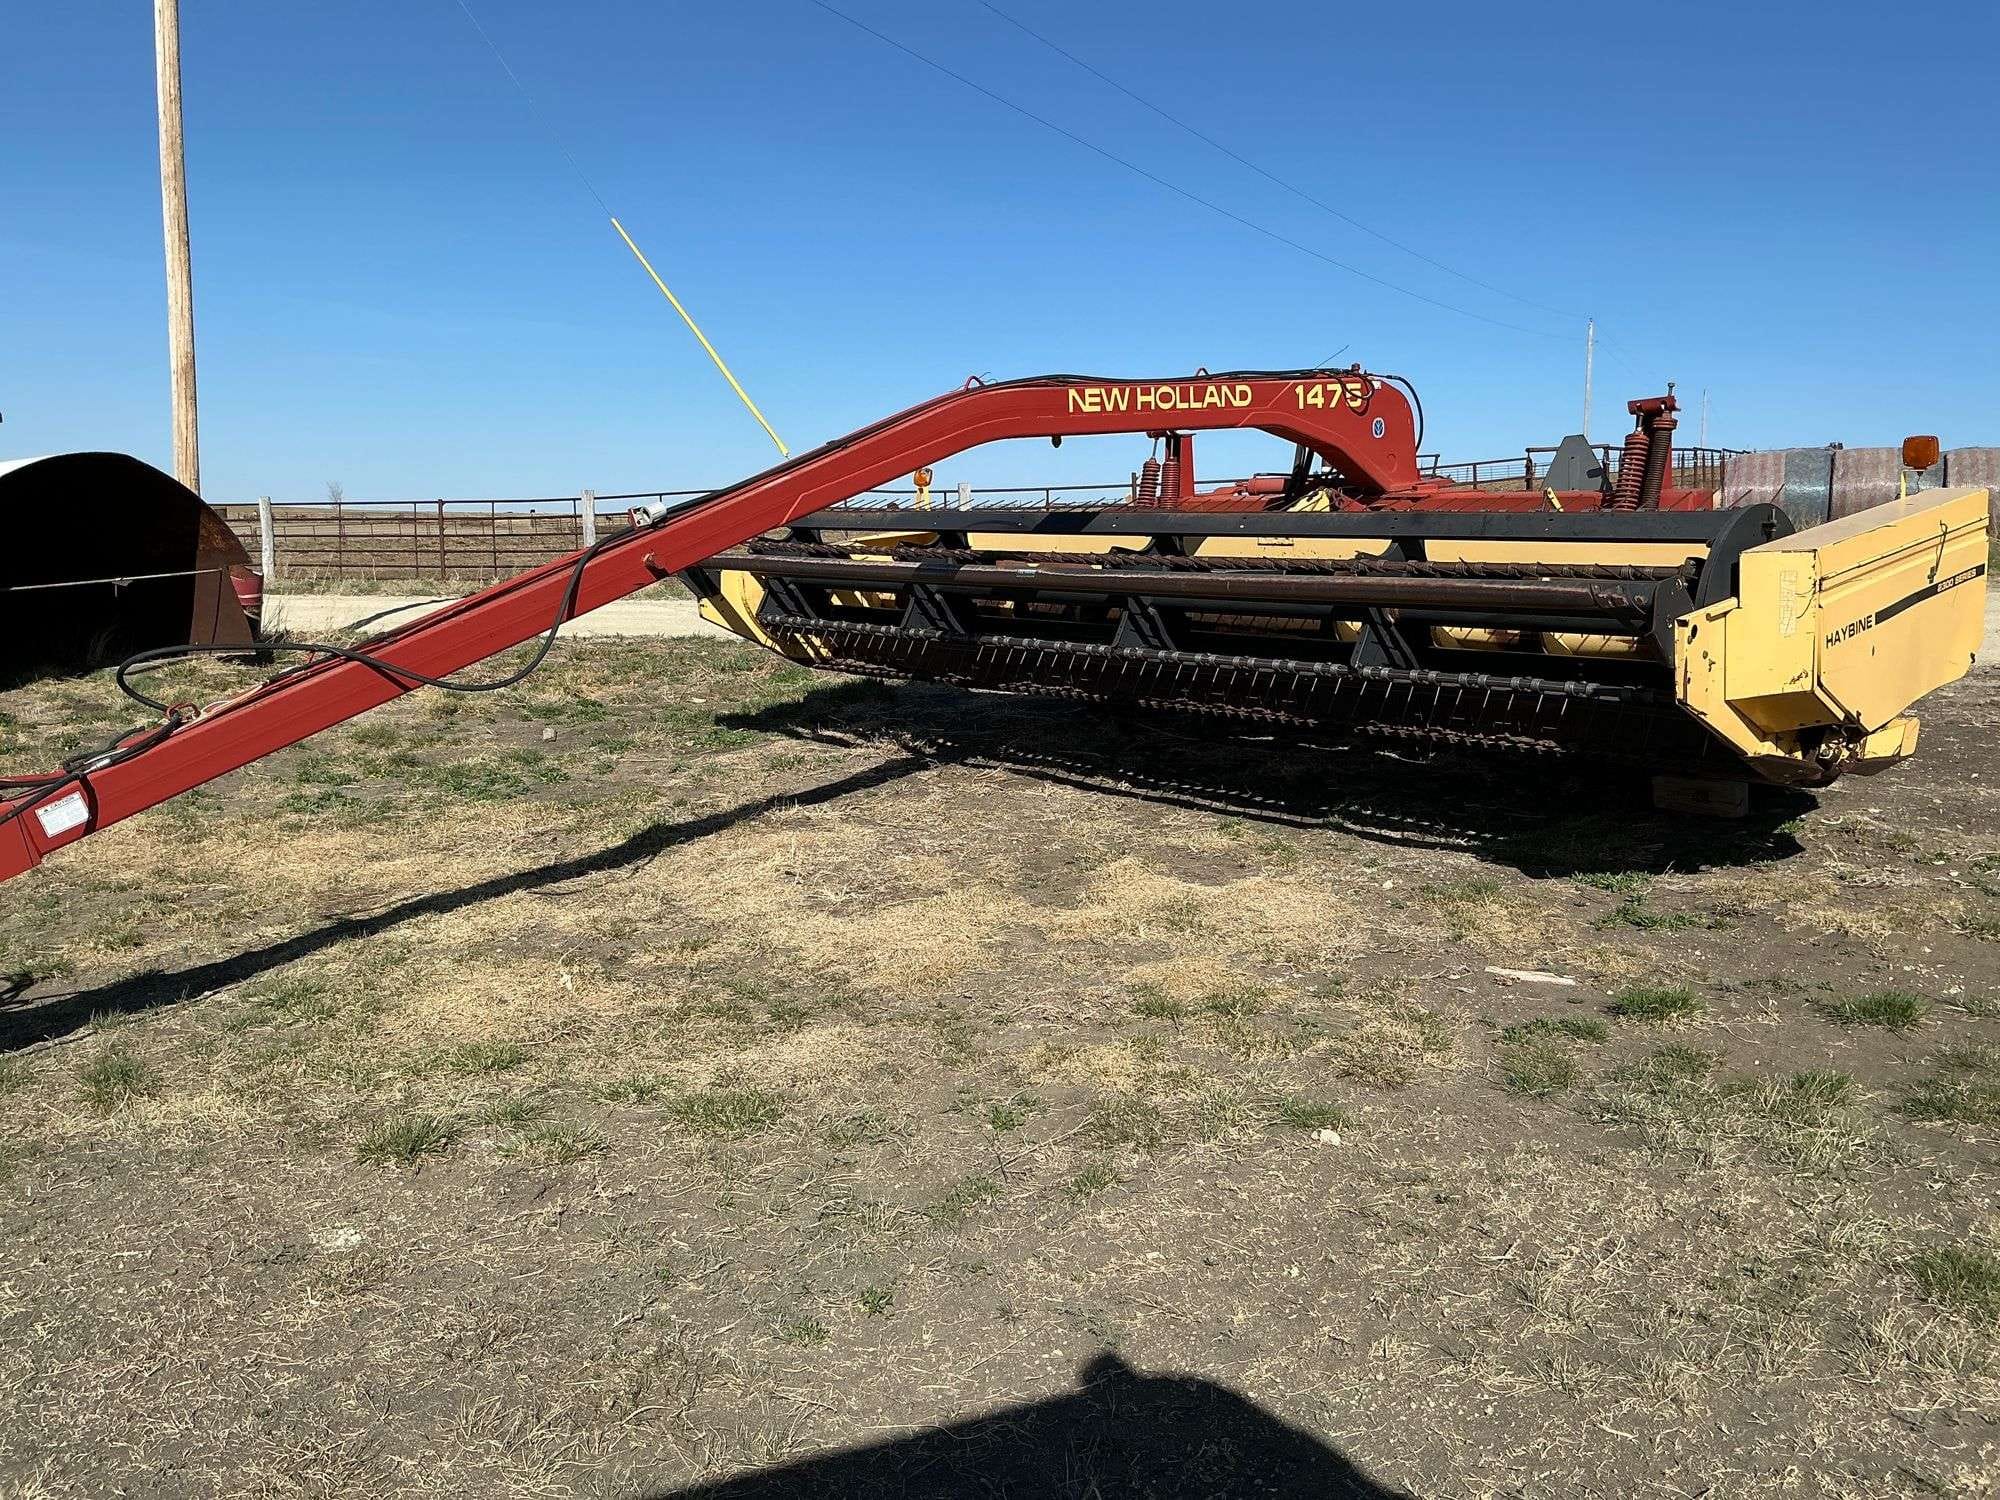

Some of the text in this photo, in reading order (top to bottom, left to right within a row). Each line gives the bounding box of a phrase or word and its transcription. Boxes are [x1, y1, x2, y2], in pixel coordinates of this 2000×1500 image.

[1068, 384, 1252, 413] NEW HOLLAND
[1294, 383, 1362, 409] 1475
[1955, 568, 1977, 584] SERIES
[1825, 614, 1873, 649] HAYBINE
